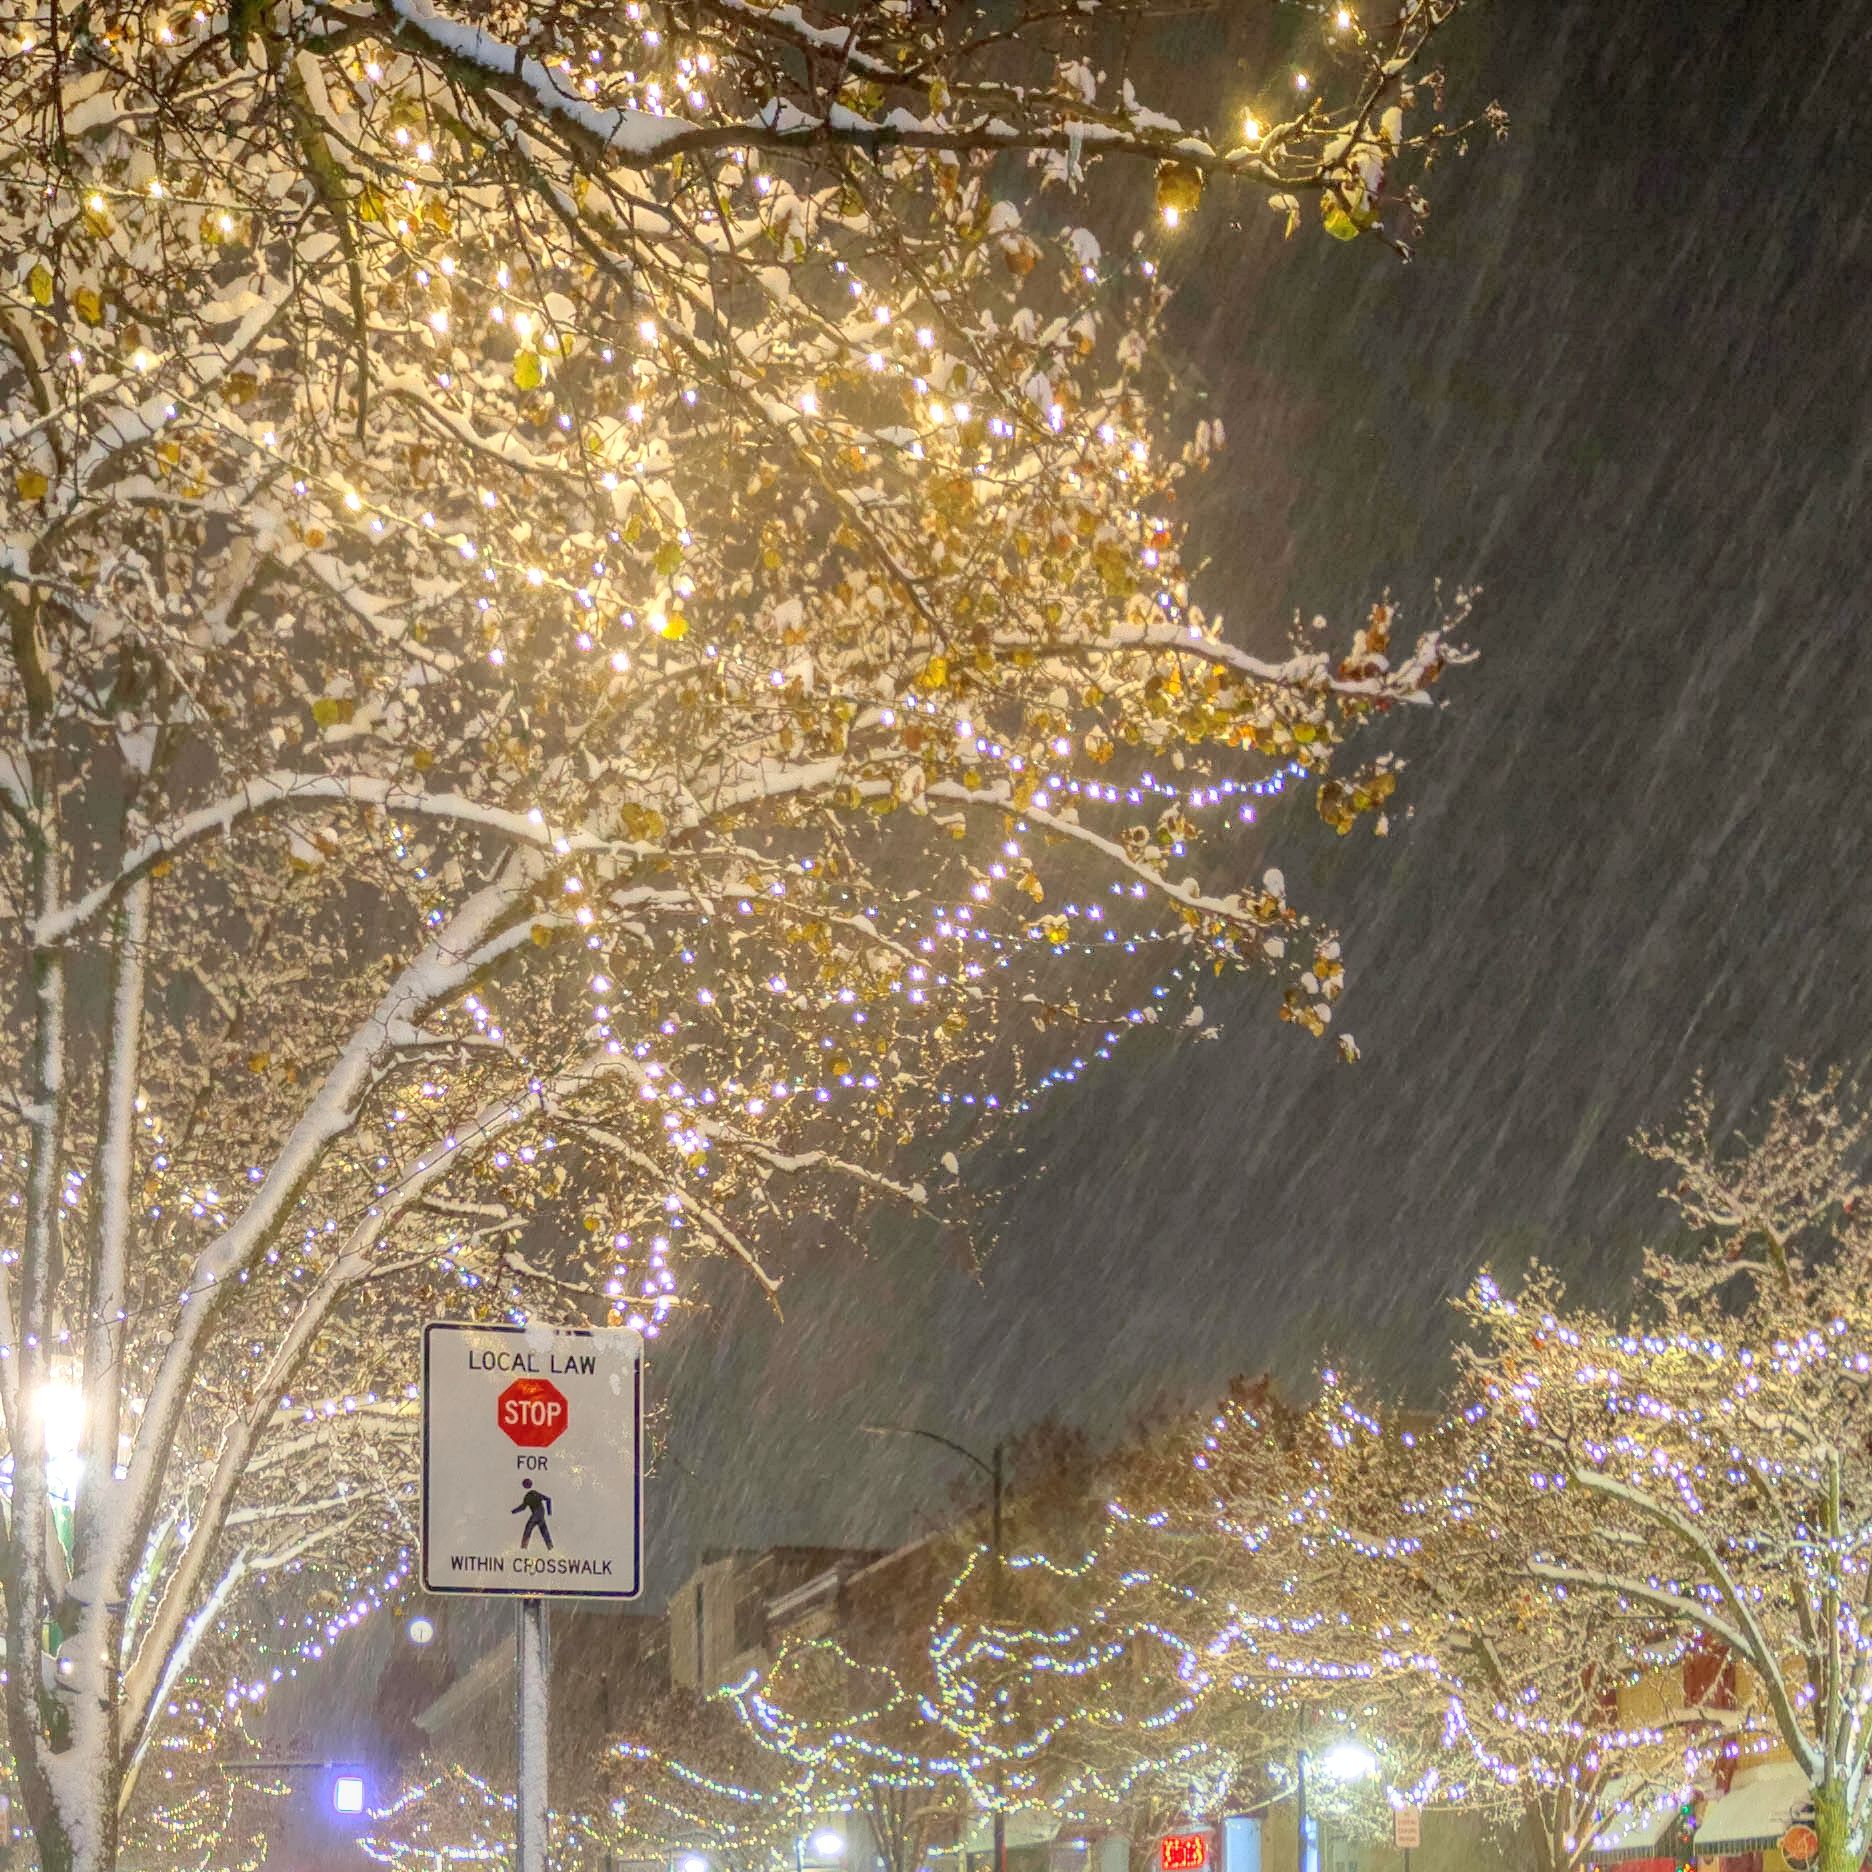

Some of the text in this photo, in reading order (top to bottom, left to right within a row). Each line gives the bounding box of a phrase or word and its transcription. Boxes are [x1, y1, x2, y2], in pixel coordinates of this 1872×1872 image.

[469, 1350, 596, 1375] LOCAL LAW
[504, 1399, 562, 1427] STOP
[516, 1455, 548, 1471] FOR
[451, 1555, 612, 1576] WITHIN CROSSWALK
